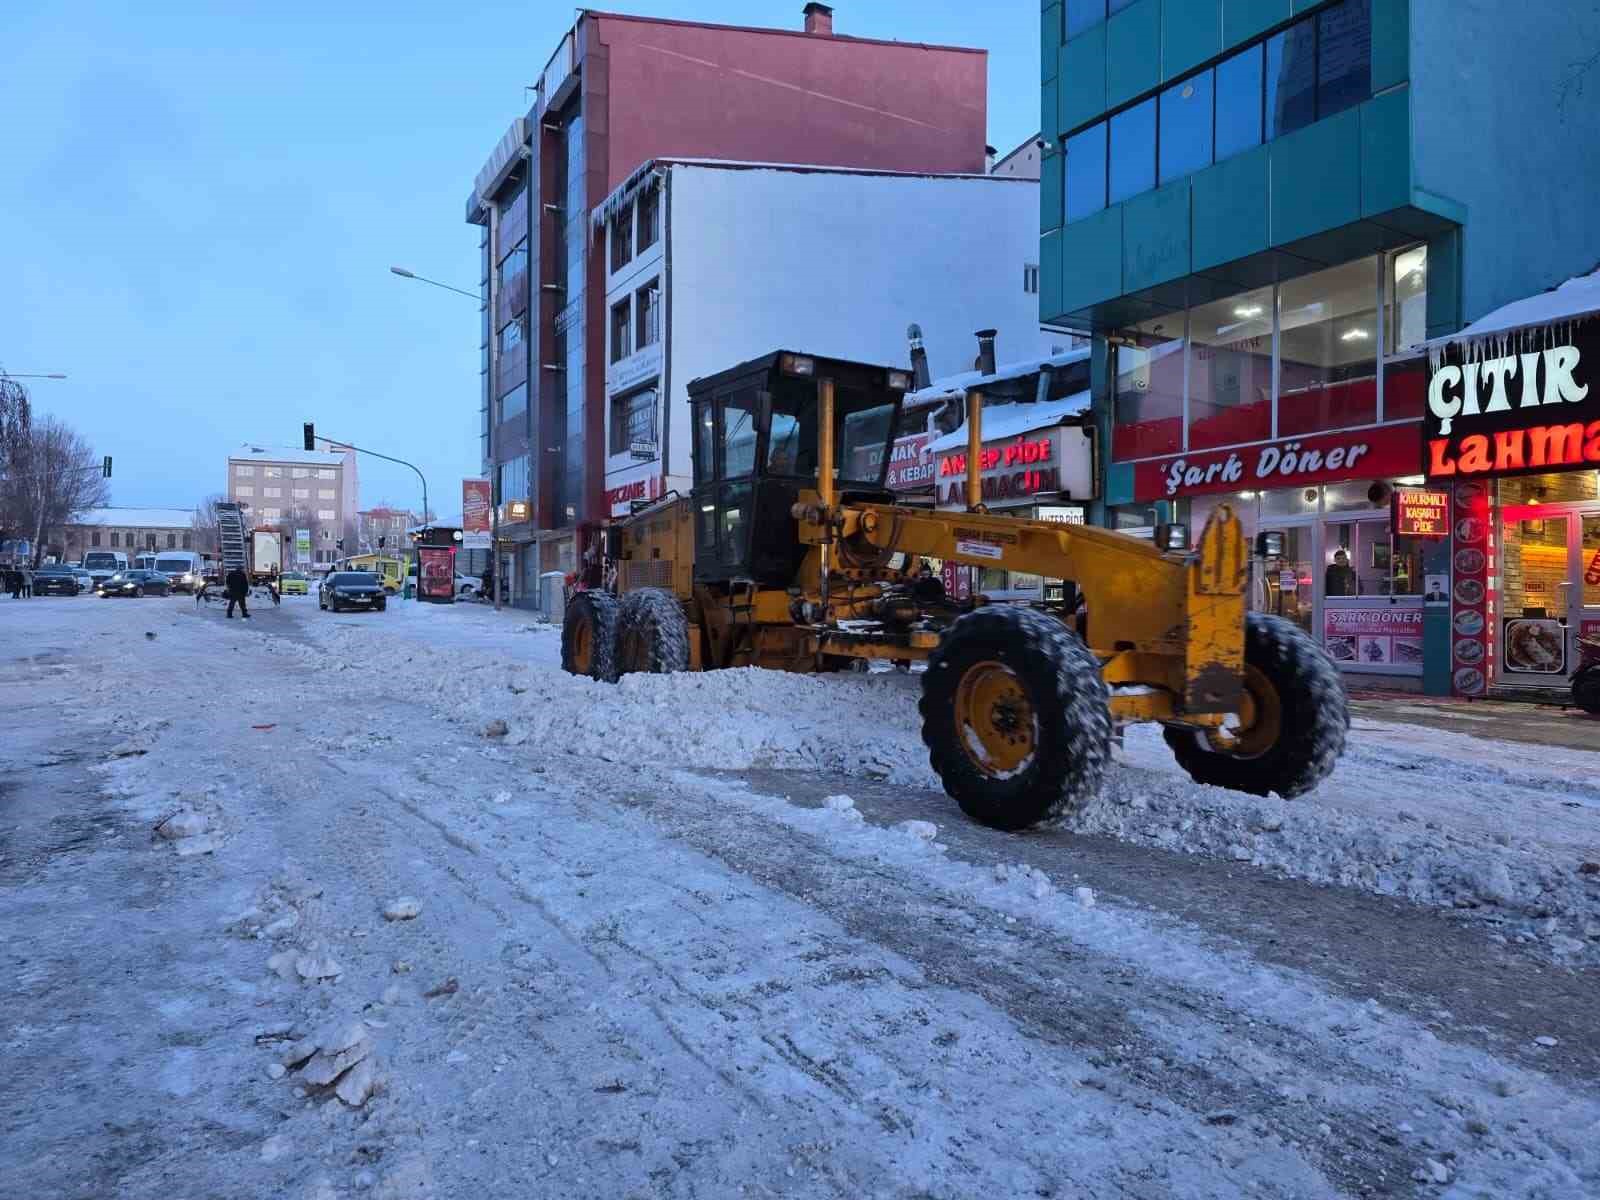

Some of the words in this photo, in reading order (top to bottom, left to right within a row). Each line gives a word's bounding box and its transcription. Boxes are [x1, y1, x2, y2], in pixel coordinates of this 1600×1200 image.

[1428, 345, 1589, 435] ÇITIR
[941, 448, 1000, 477] ANEP
[1166, 453, 1243, 495] Şark
[1255, 442, 1369, 479] Döner
